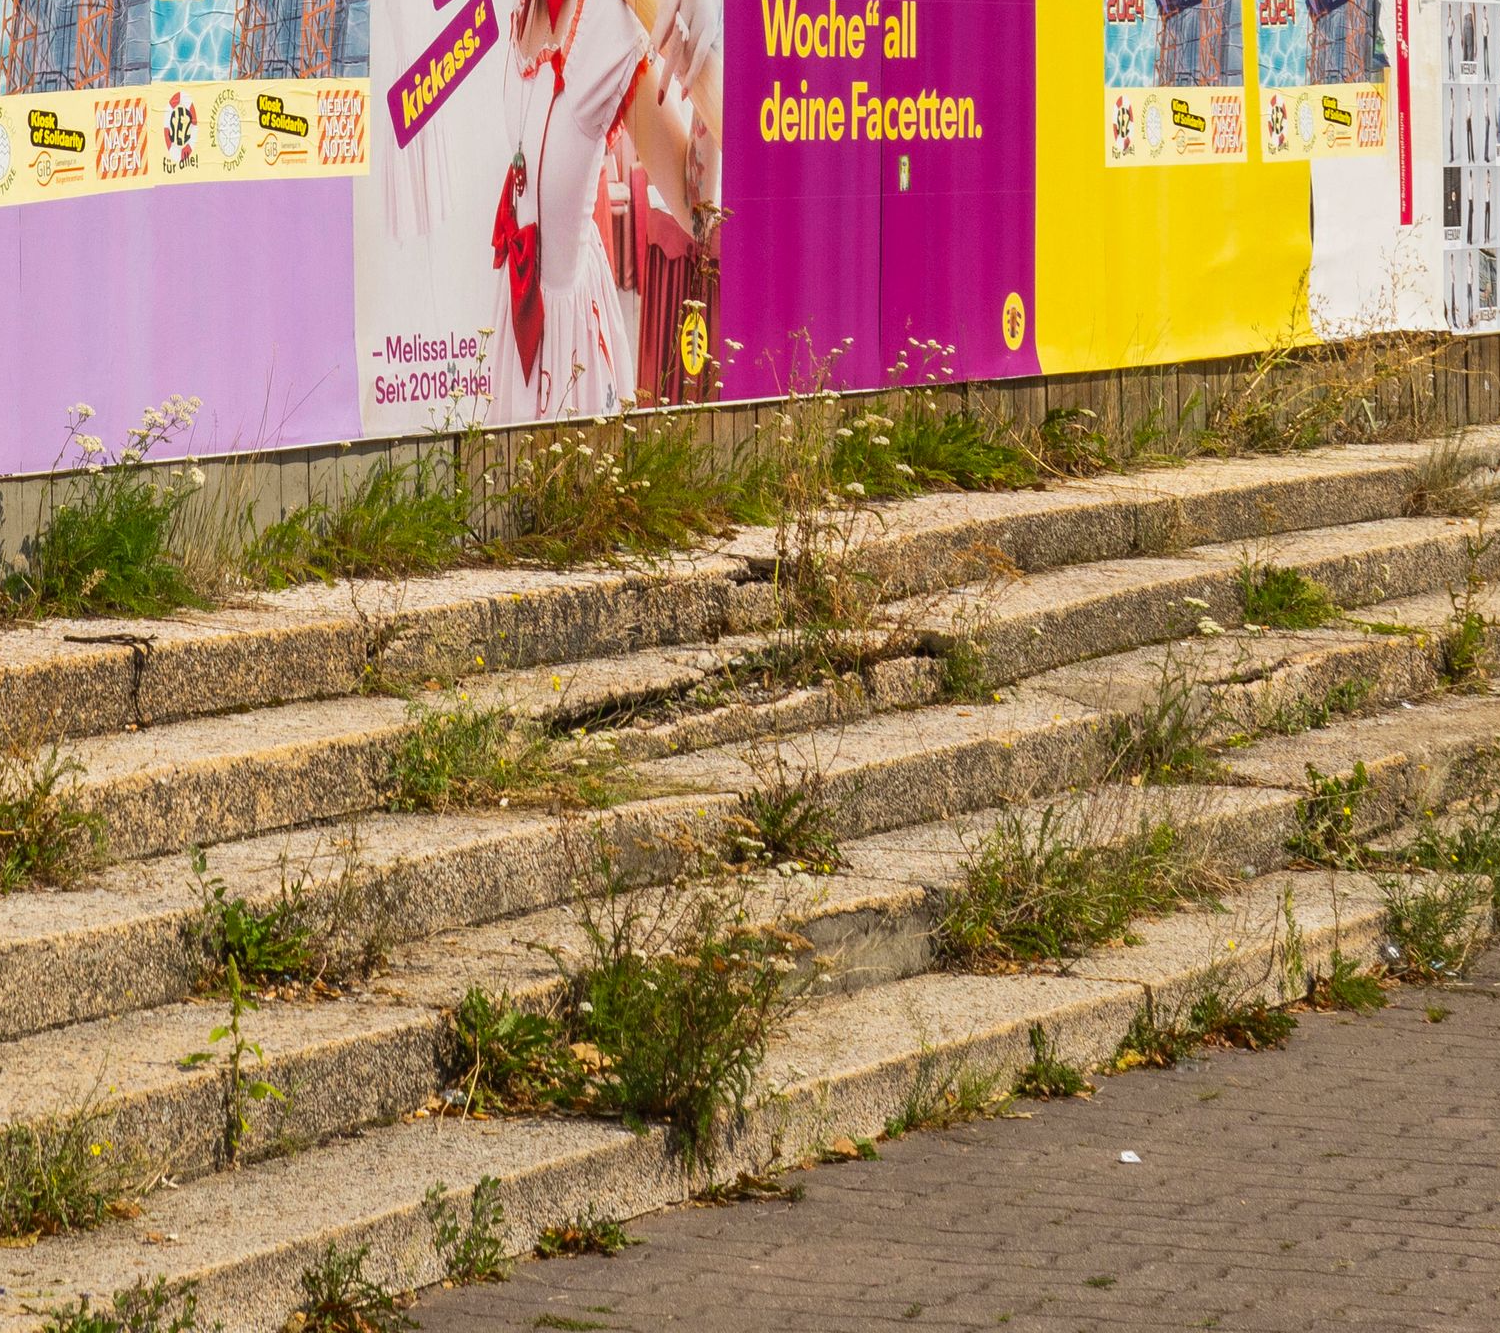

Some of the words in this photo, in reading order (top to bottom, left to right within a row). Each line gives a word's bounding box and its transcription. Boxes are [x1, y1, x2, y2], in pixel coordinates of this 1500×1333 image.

[883, 8, 918, 61] all
[759, 85, 845, 144] deine
[850, 78, 983, 143] Facetten.
[386, 333, 447, 364] Melissa
[451, 332, 477, 359] Lee
[375, 374, 407, 405] Seit
[410, 371, 448, 401] 2018
[449, 366, 491, 397] dabei
